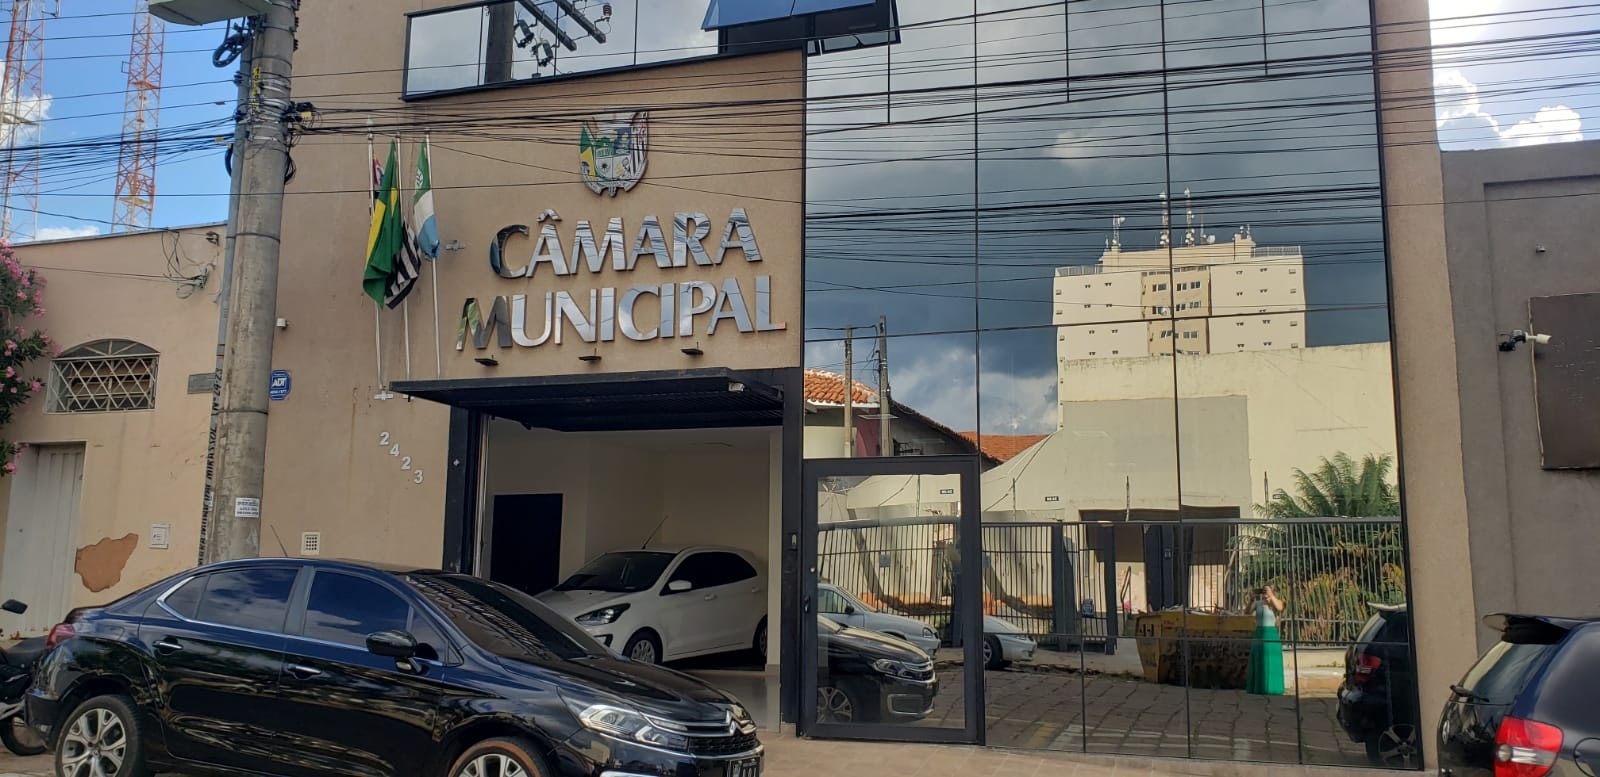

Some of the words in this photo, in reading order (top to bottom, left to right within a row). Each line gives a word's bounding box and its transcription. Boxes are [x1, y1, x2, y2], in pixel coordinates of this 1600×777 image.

[489, 207, 763, 280] CÂMARA
[455, 274, 787, 351] MUNICIPAL
[272, 378, 287, 387] ADT
[379, 431, 424, 484] 2423
